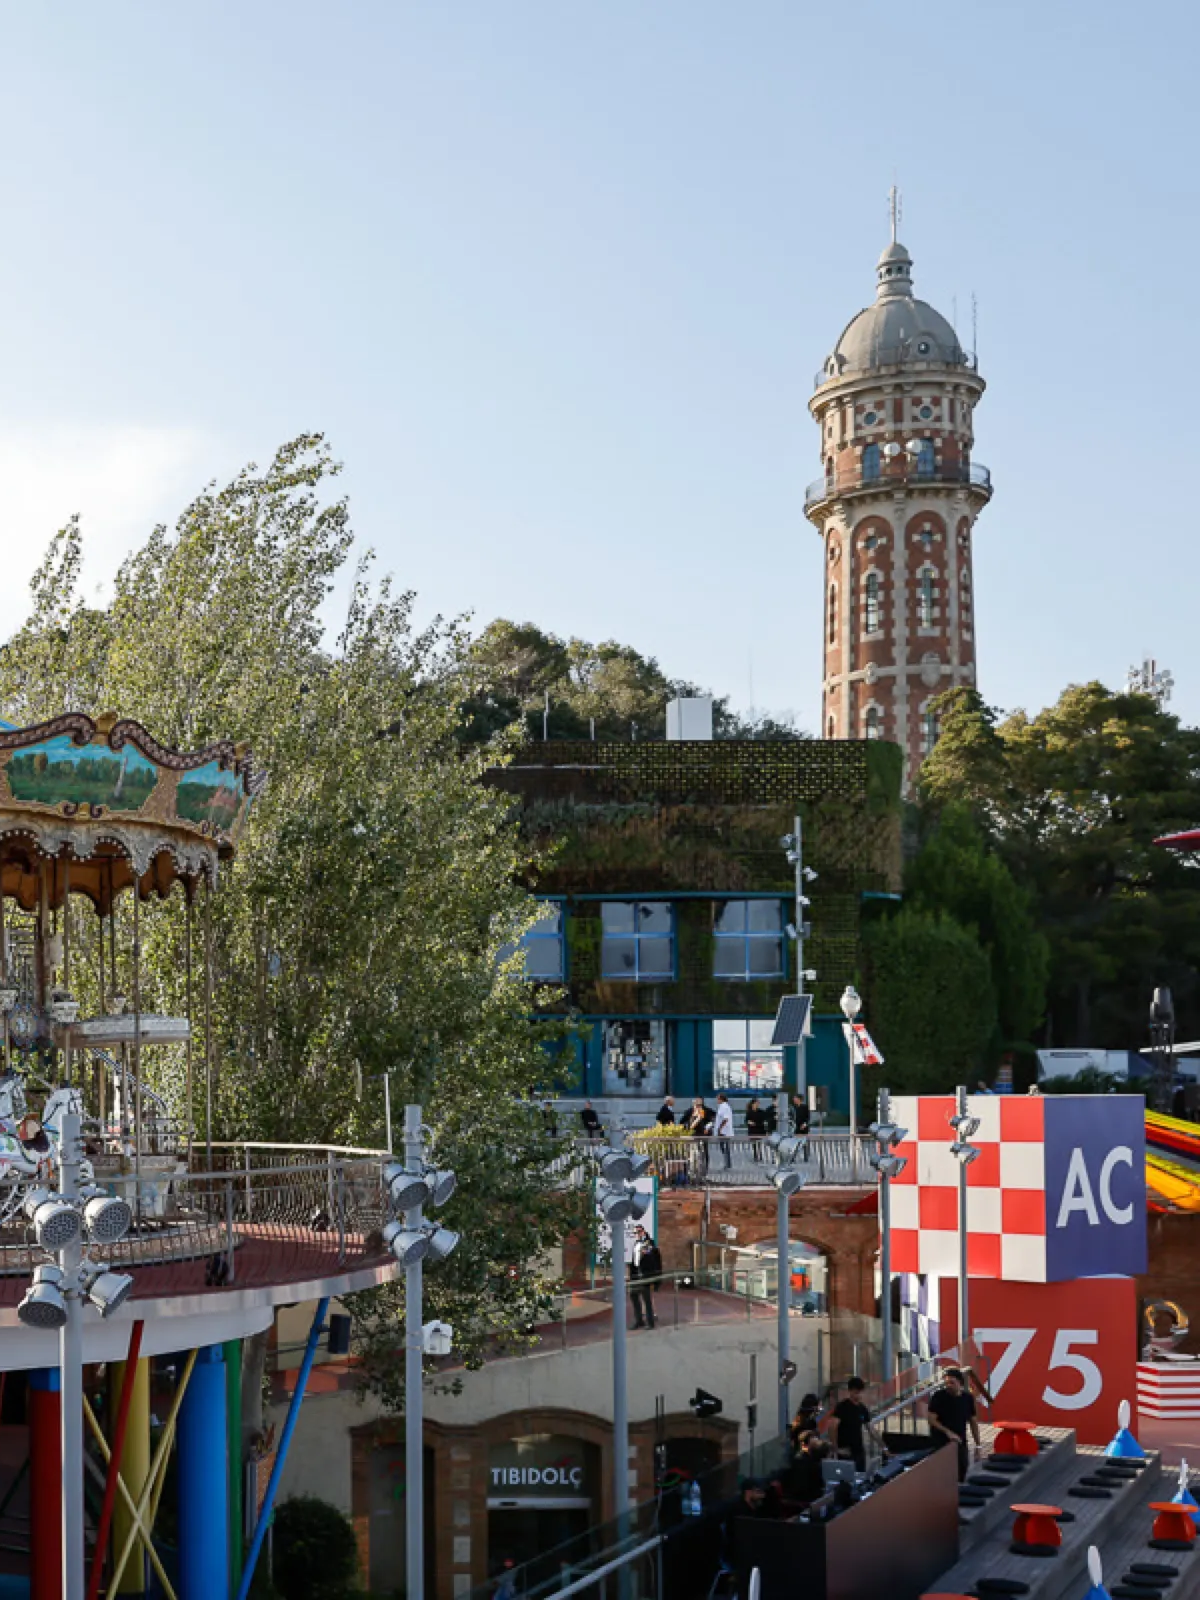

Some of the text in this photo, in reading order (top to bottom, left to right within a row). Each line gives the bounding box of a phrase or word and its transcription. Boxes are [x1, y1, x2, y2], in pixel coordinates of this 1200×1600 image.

[1055, 1145, 1134, 1228] AC
[972, 1327, 1103, 1411] 75
[491, 1467, 582, 1489] TIBIDOLÇ
